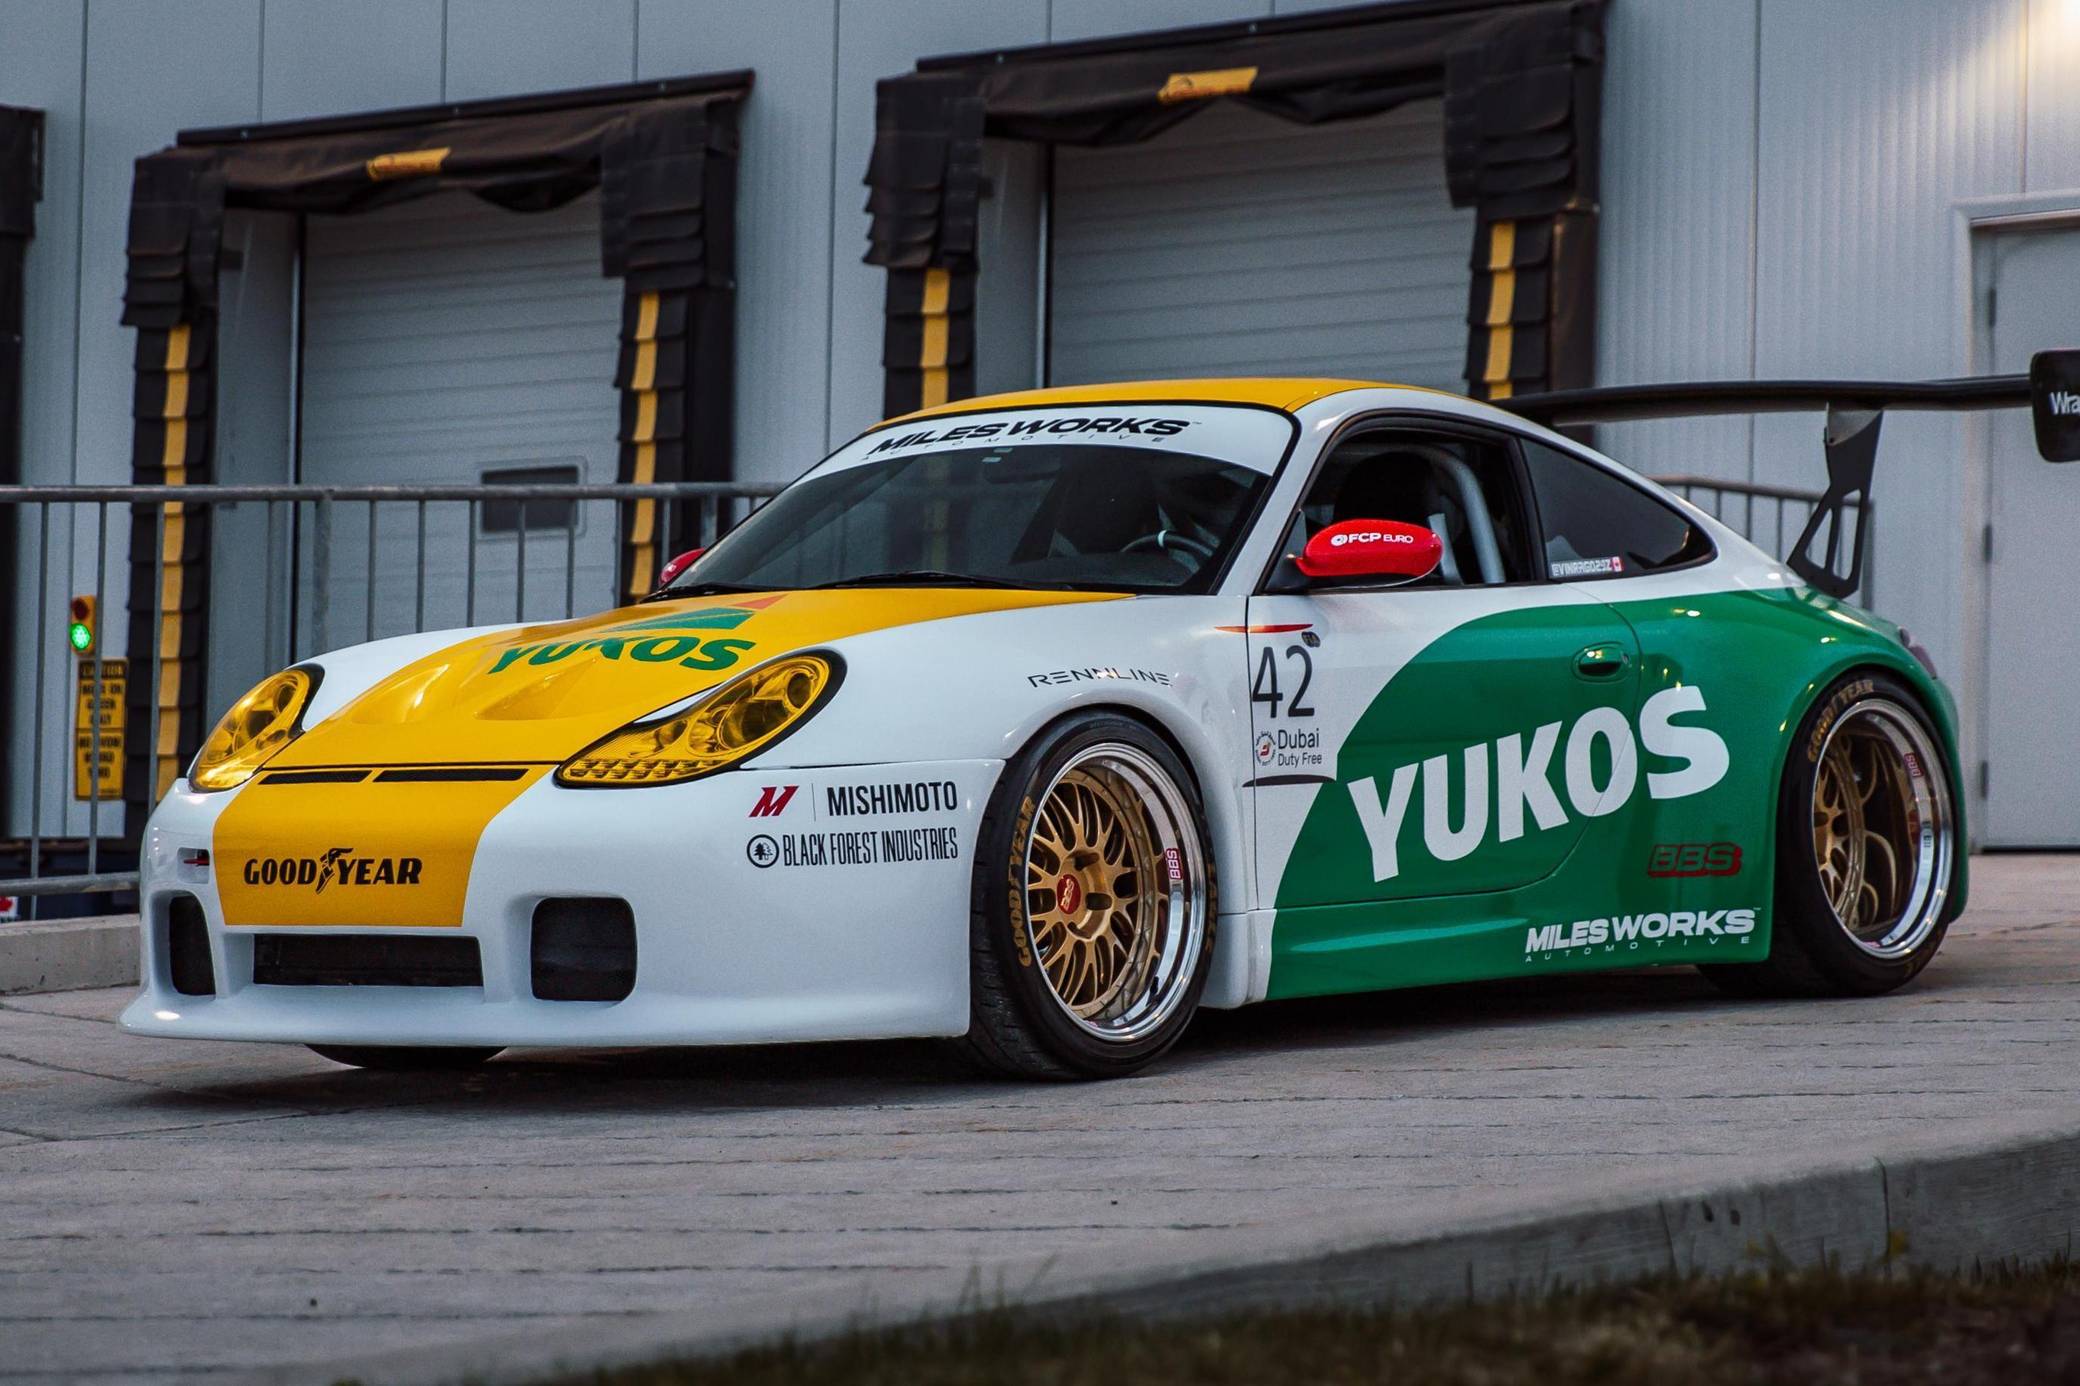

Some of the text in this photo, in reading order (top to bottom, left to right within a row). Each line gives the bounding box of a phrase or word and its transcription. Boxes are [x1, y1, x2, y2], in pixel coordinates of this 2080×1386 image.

[1348, 532, 1414, 544] FCP EURO
[1252, 644, 1315, 718] 42
[1278, 728, 1320, 750] Dubai
[1278, 751, 1322, 768] Duty Free
[827, 781, 958, 816] MISHIMOTO
[1347, 685, 1730, 883] YUKOS
[783, 826, 959, 866] BLACK FOREST INDUSTRIES
[1649, 842, 1743, 878] BBS
[1525, 936, 1750, 963] AUTOMOTIVE
